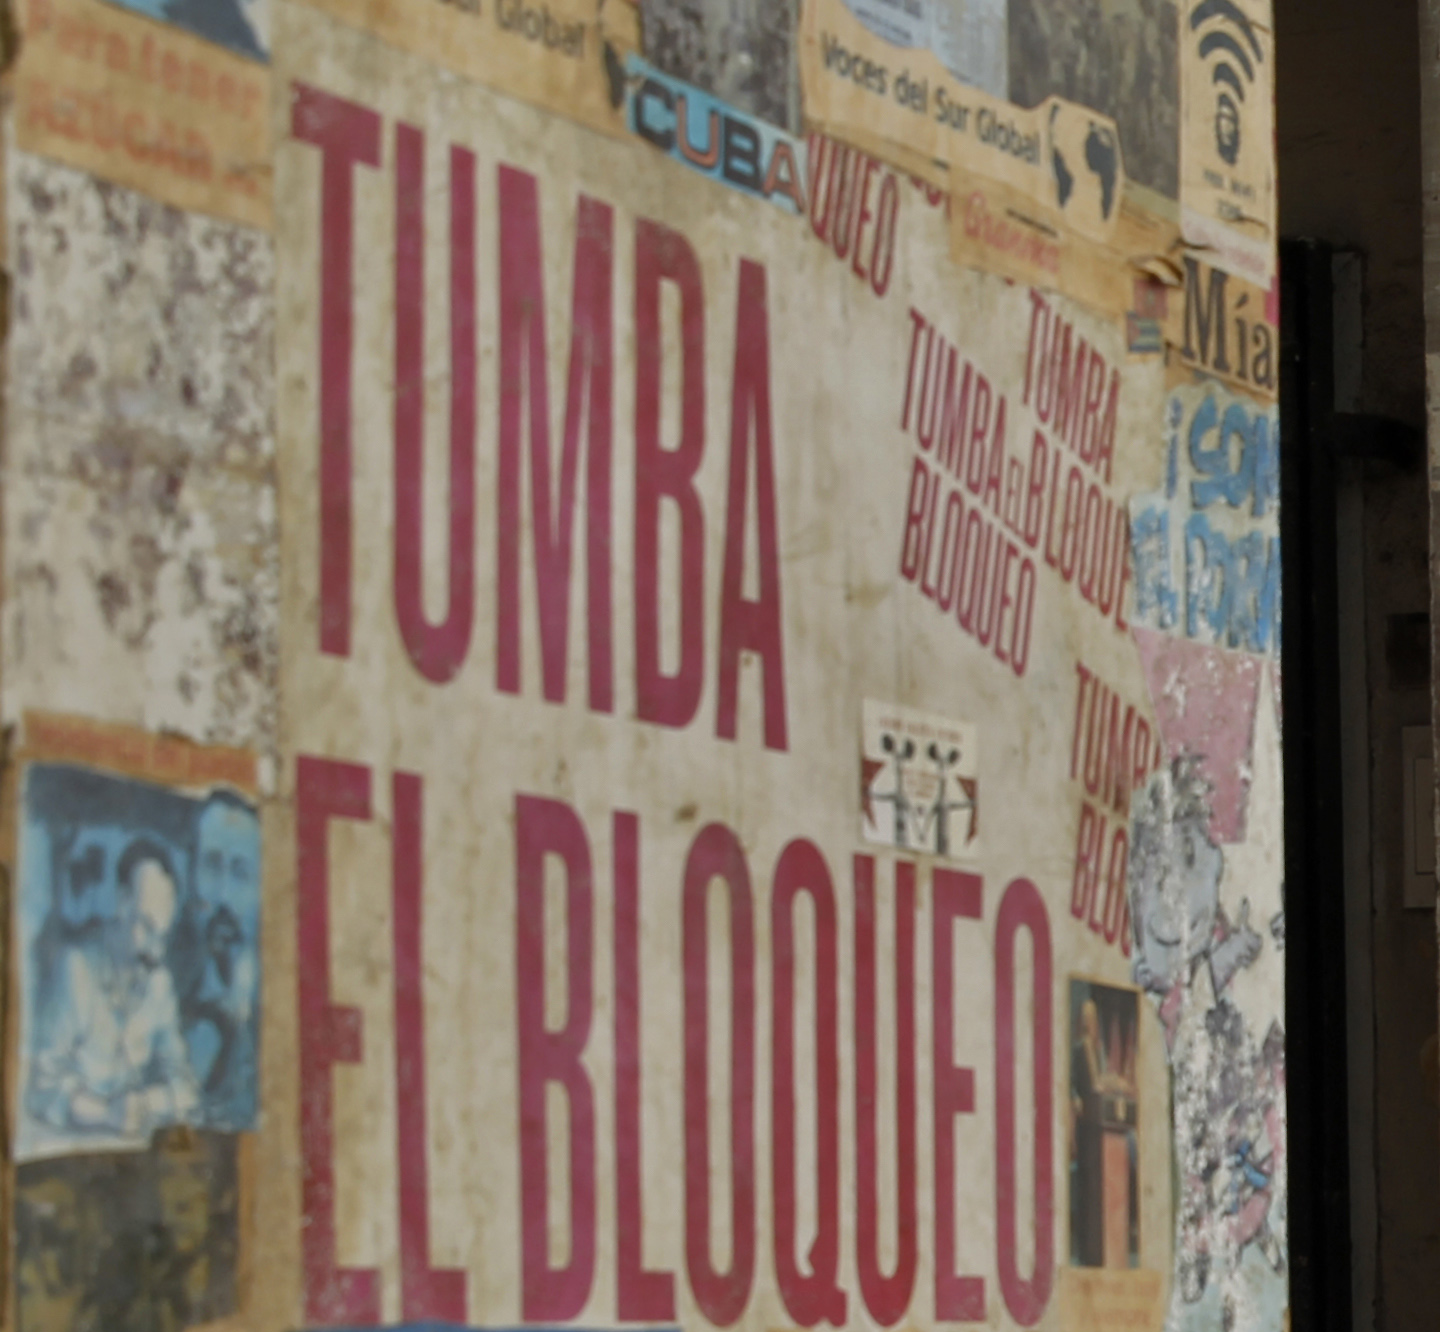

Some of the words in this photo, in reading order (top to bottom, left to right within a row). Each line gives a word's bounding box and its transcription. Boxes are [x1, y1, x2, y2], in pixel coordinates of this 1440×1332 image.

[632, 76, 803, 200] CUBA
[821, 34, 887, 95] Voces
[895, 71, 930, 114] del
[934, 87, 969, 131] Sur
[977, 104, 1041, 166] Global
[290, 79, 788, 752] TUMBA
[901, 306, 1008, 520] TUMBA
[1005, 456, 1026, 540] EL
[1023, 289, 1120, 485] TUMBA
[1182, 257, 1273, 389] Mía
[900, 454, 1037, 679] BLOQUEO
[1026, 428, 1131, 632] BLOQUE
[296, 754, 468, 1325] EL
[515, 792, 1054, 1329] BLOQUEO
